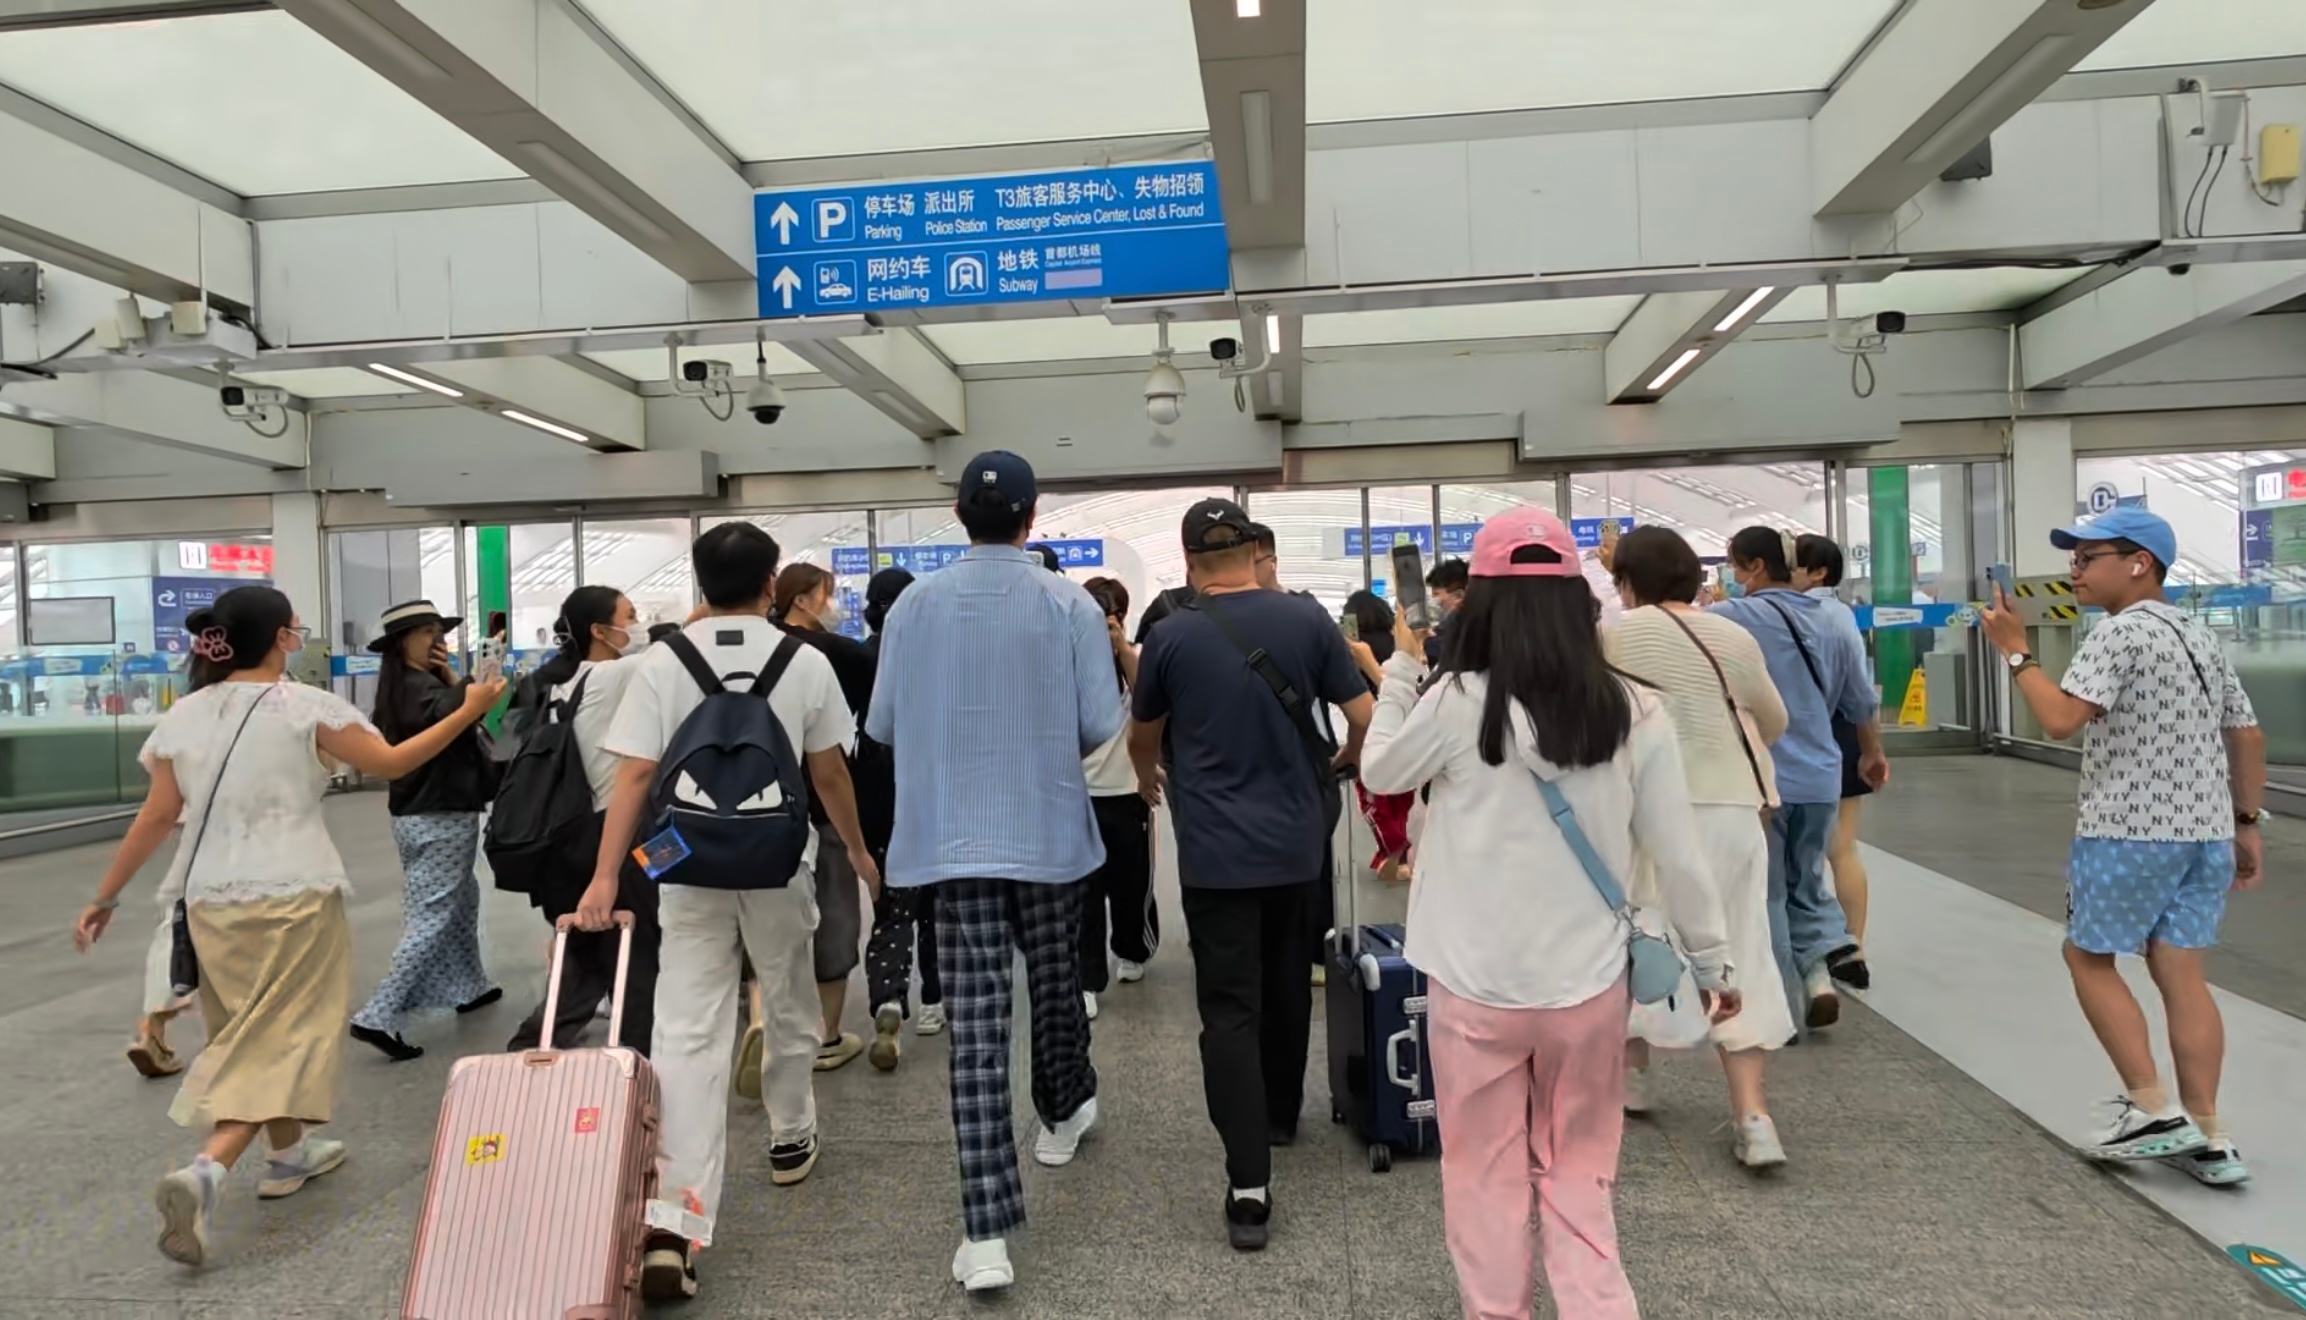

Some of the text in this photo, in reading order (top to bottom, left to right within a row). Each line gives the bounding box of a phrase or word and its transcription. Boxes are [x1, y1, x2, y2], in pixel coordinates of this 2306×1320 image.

[864, 193, 915, 219] 停车场
[924, 189, 975, 215] 派出所
[818, 201, 847, 238] P
[925, 218, 988, 236] Police Station
[996, 202, 1204, 232] Passenger Service Center, Lost & Found
[864, 224, 902, 241] Parking
[867, 255, 931, 282] 网约车
[998, 248, 1039, 271] 地铁
[867, 286, 930, 303] E-Hailing
[999, 277, 1039, 294] Subway
[2137, 711, 2159, 723] NY
